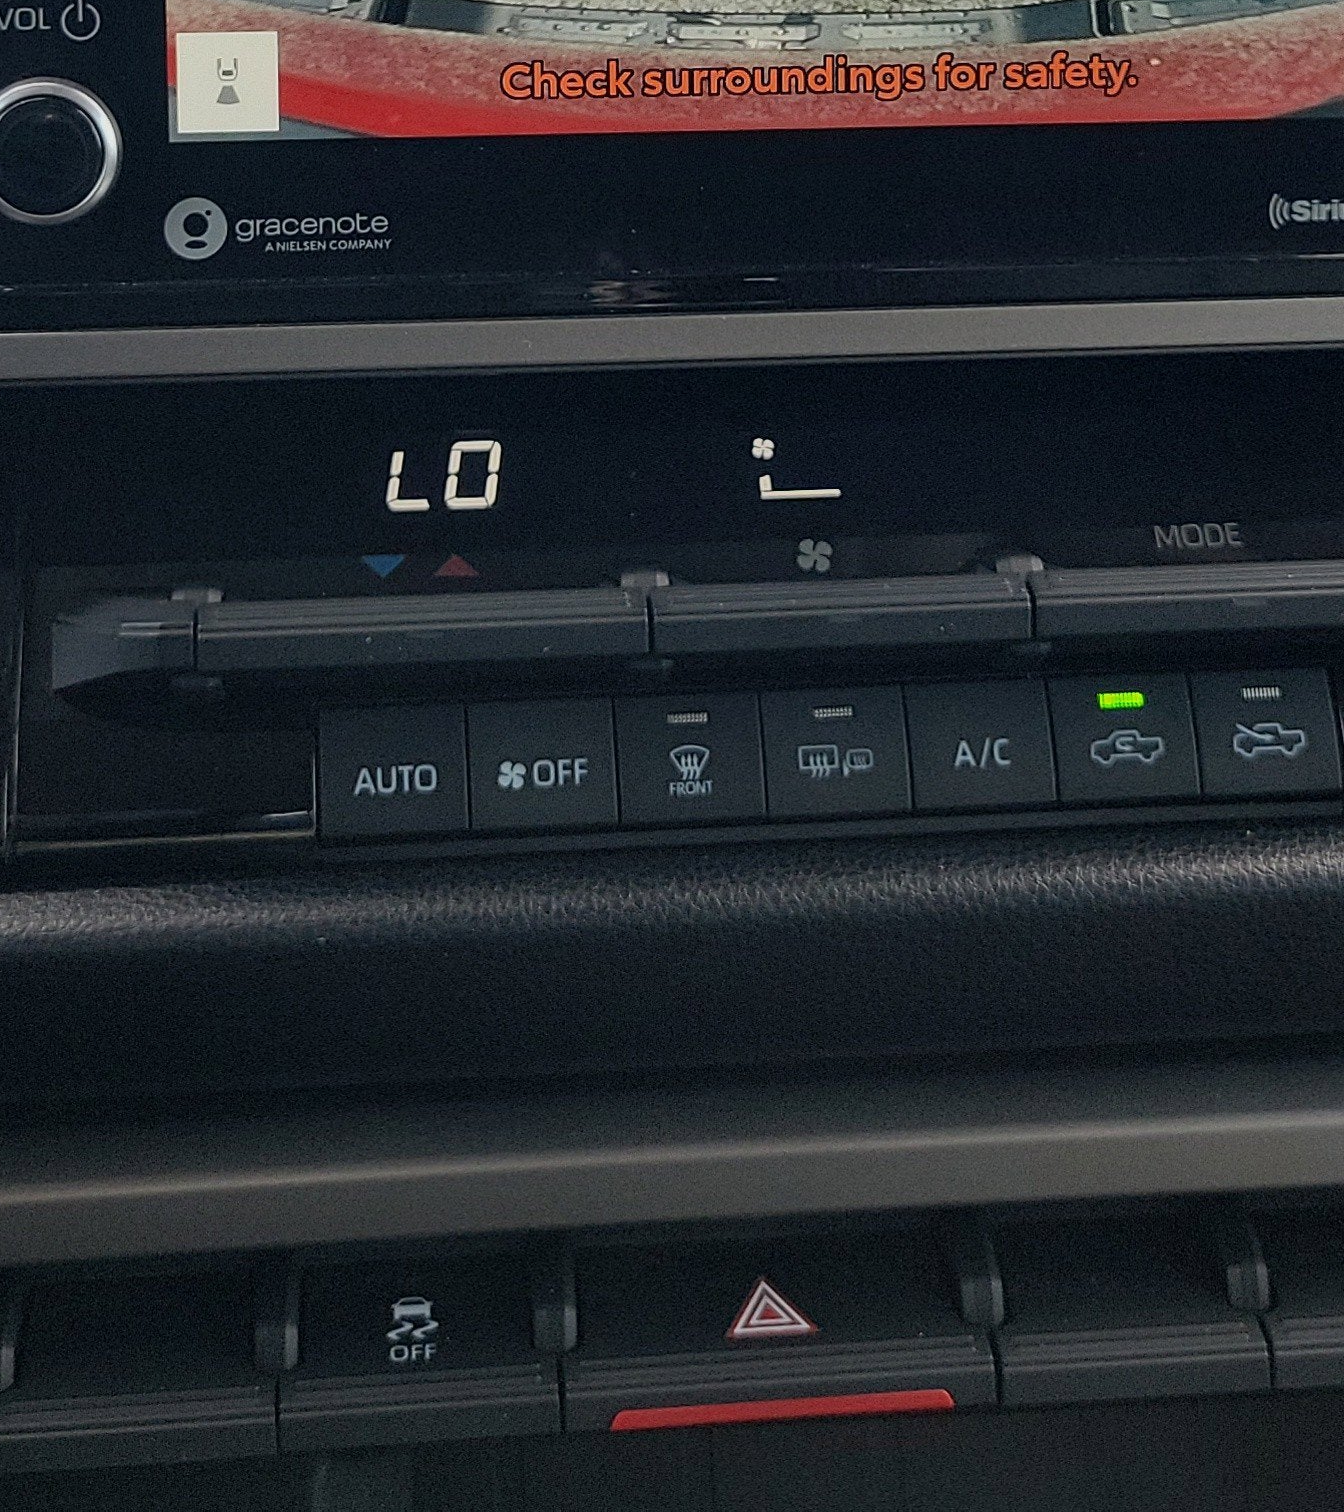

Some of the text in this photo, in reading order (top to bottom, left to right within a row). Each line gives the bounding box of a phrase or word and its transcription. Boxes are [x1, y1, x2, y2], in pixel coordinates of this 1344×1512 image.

[500, 51, 1139, 101] Check surroundings for safety.
[235, 212, 389, 242] gracenote
[265, 238, 392, 252] A NIELSEN COMPANY
[1154, 522, 1244, 551] MODE
[953, 737, 1011, 770] A/C
[355, 763, 437, 795] AUTO
[533, 758, 588, 786] OFF
[669, 780, 713, 796] FRONT
[389, 1342, 437, 1363] OFF
